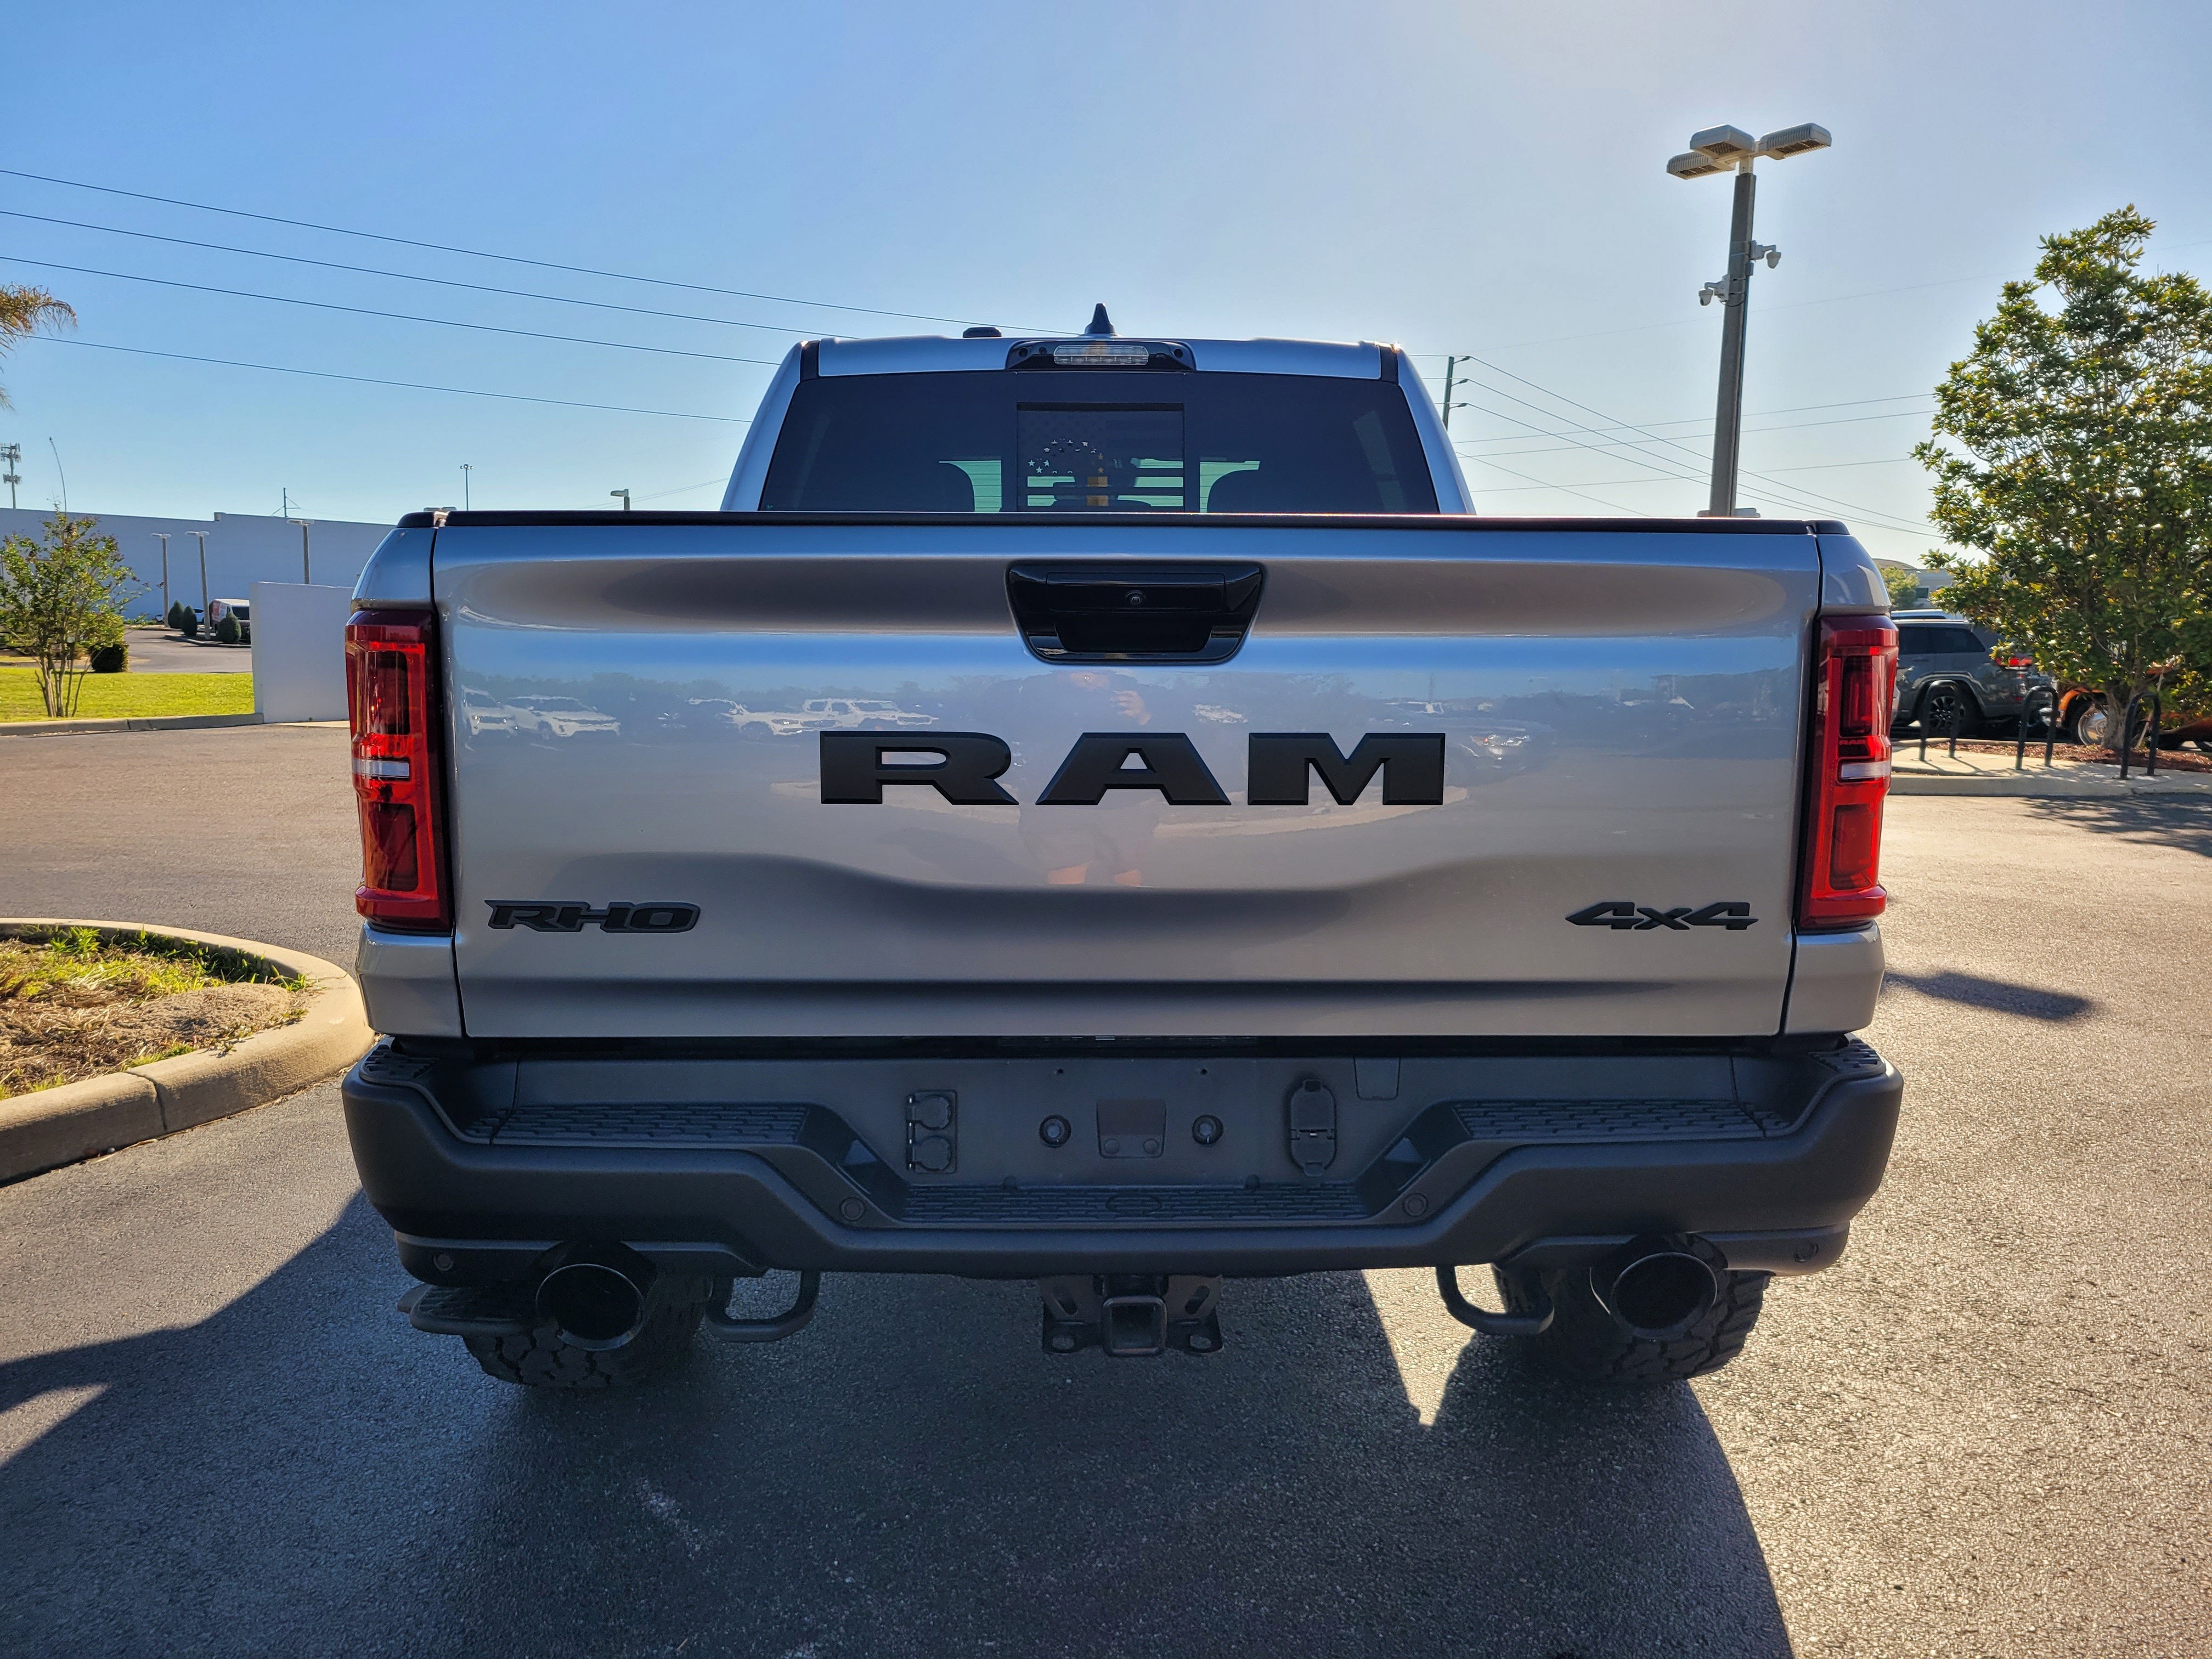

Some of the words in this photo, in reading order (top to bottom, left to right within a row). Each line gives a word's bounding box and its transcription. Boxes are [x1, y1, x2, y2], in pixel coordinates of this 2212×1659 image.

[820, 730, 1445, 805] RAM
[484, 900, 701, 933] RHO
[1565, 902, 1759, 930] 4x4
